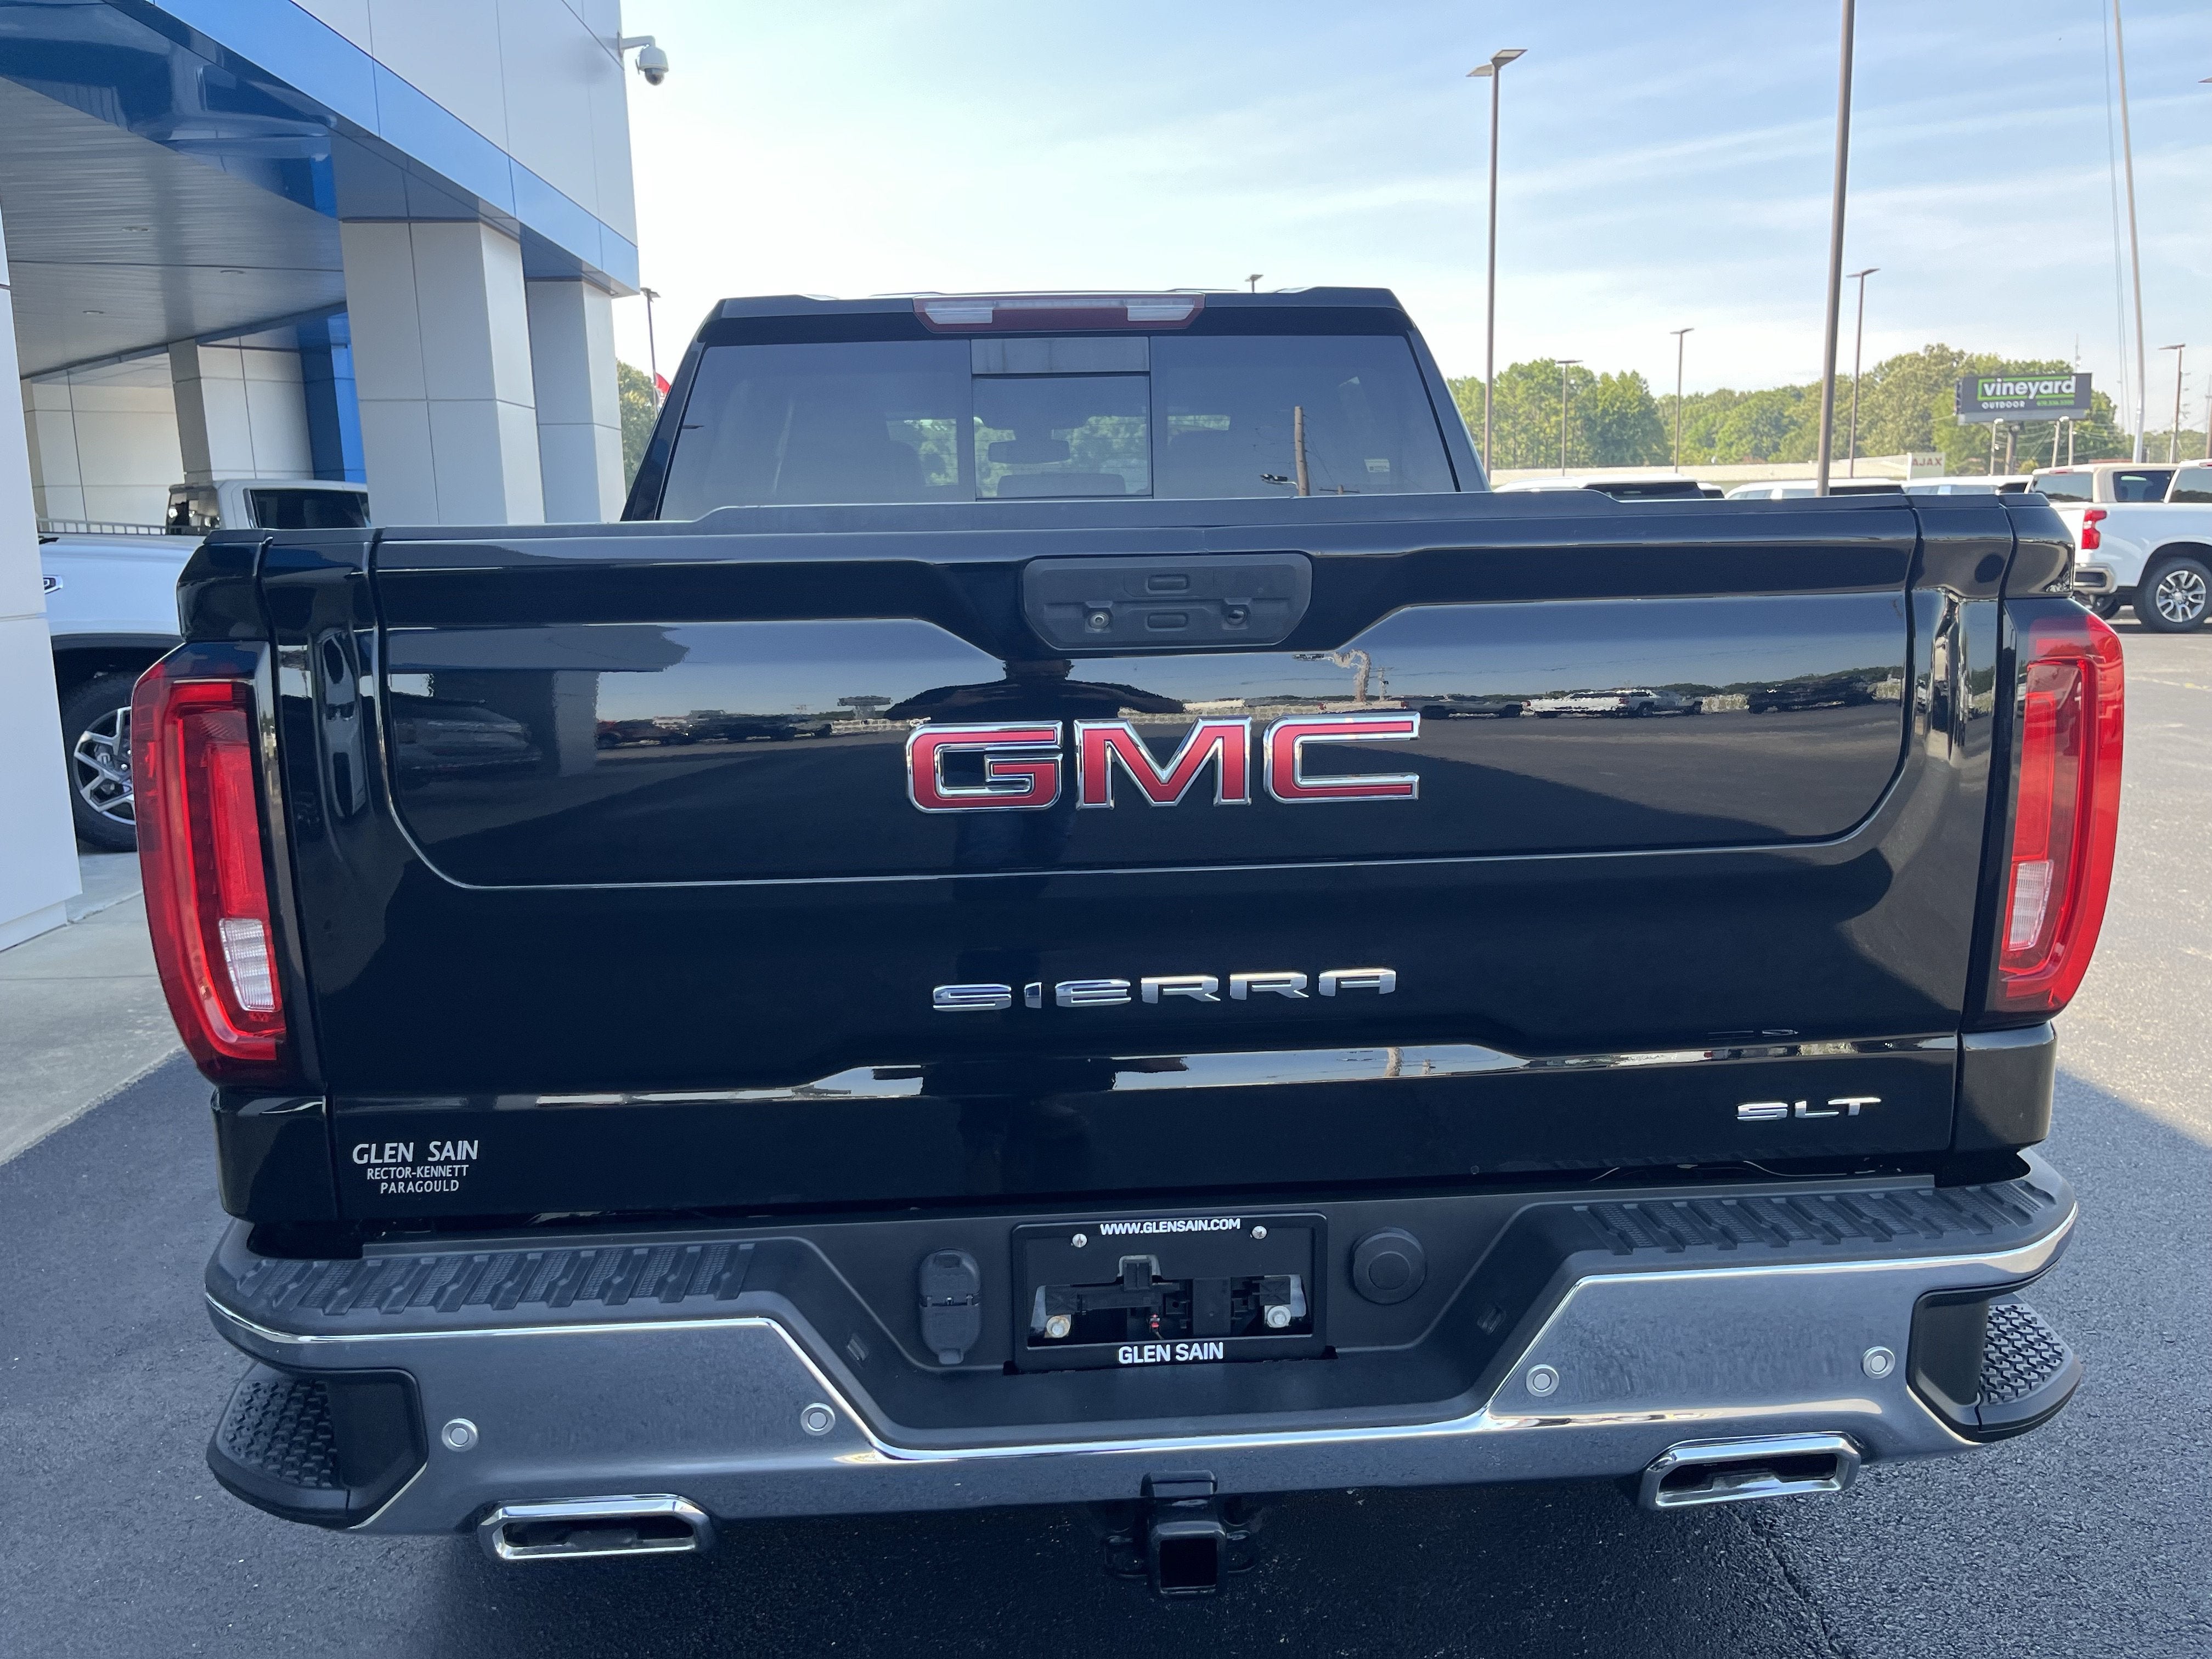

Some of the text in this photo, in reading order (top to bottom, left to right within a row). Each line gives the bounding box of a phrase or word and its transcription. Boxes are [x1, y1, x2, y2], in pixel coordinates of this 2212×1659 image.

[1983, 375, 2076, 399] vineyard
[1981, 400, 2025, 410] OUTDOOR
[1912, 456, 1942, 466] AJAX
[905, 712, 1421, 814] GMC
[933, 968, 1397, 1011] SIERRA
[1736, 1097, 1882, 1121] SLT
[353, 1140, 478, 1164] GLEN SAIN
[367, 1165, 469, 1180] RECTOR-KENNETT
[380, 1180, 459, 1194] PARAGOULD
[1100, 1218, 1241, 1235] WWW.GLENSAIN.COM
[1118, 1342, 1223, 1364] GLEN SAIN
